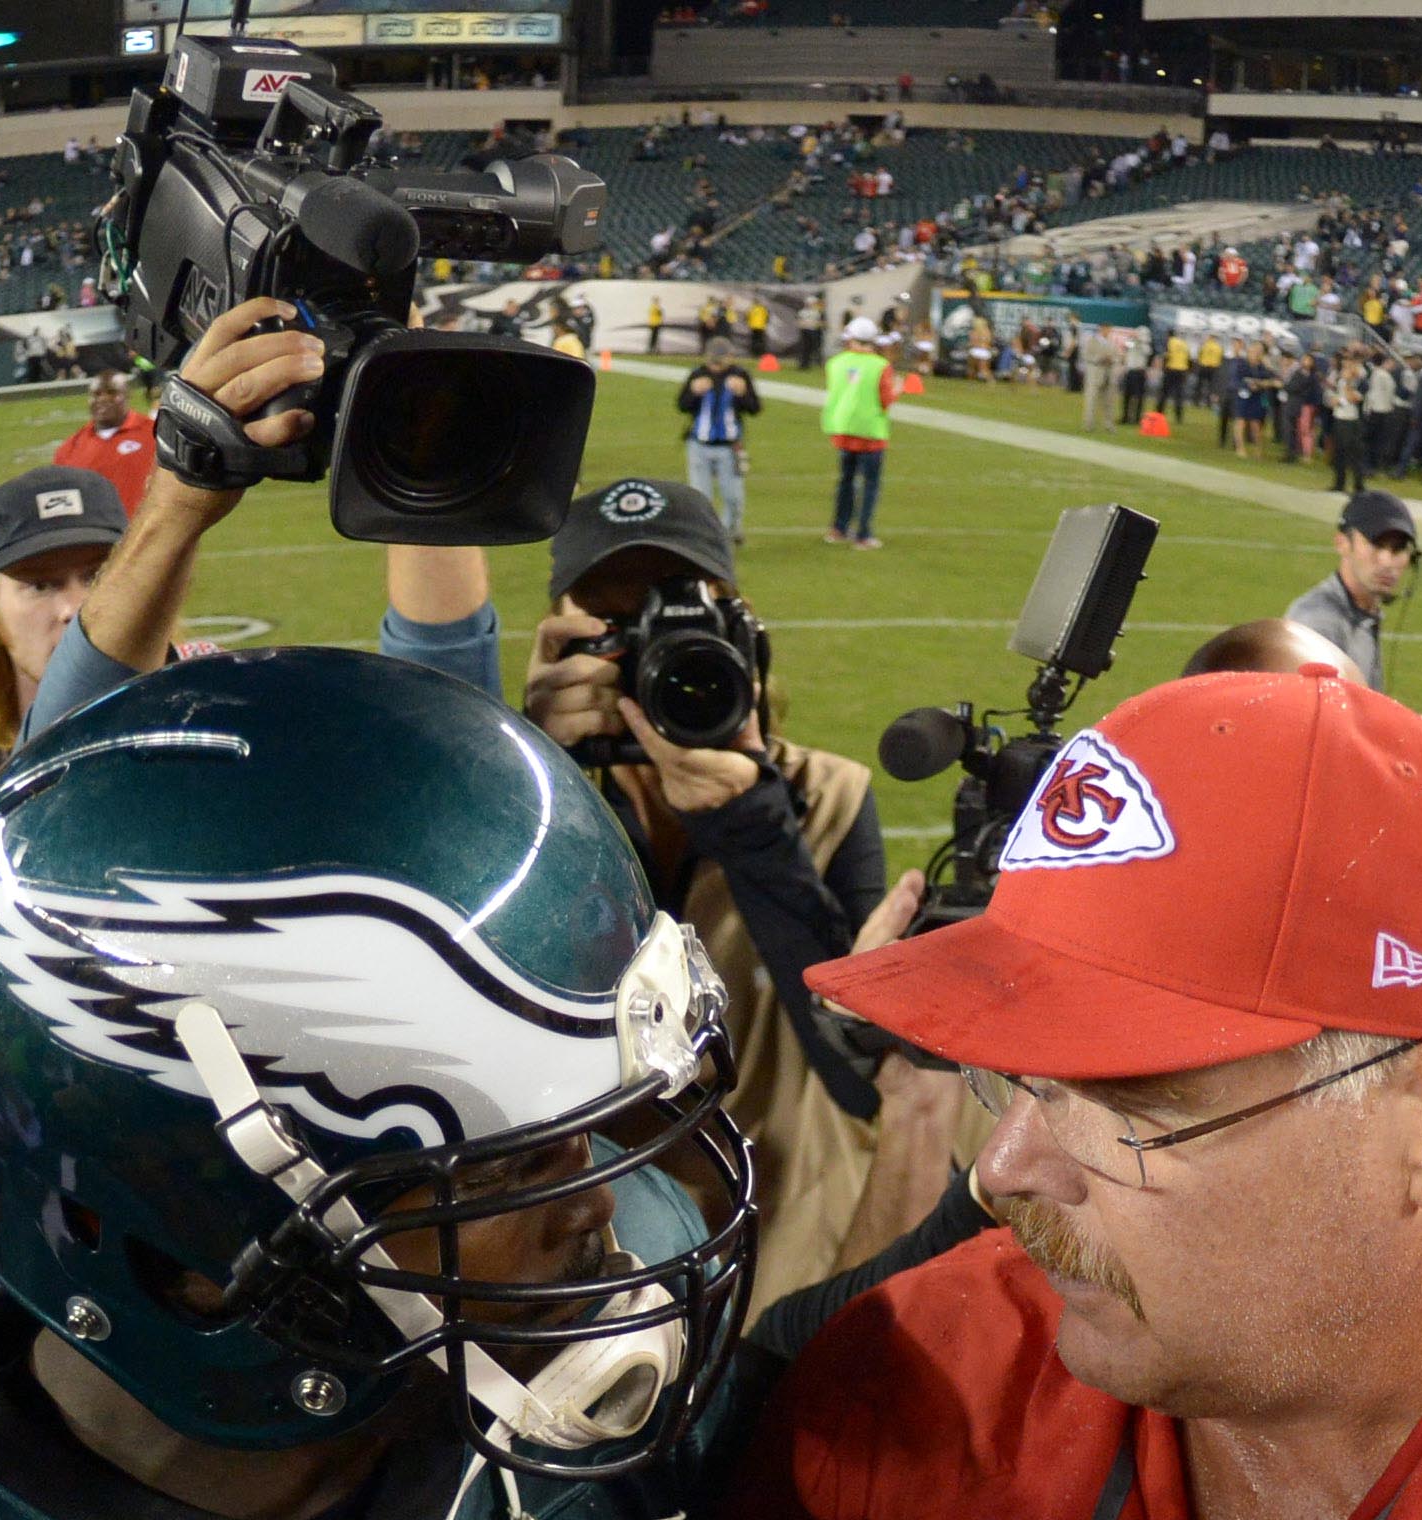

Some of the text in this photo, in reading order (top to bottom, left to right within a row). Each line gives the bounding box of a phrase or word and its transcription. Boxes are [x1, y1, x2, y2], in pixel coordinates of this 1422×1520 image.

[251, 74, 303, 94] AV
[169, 390, 212, 427] Canon
[1036, 759, 1127, 850] KC
